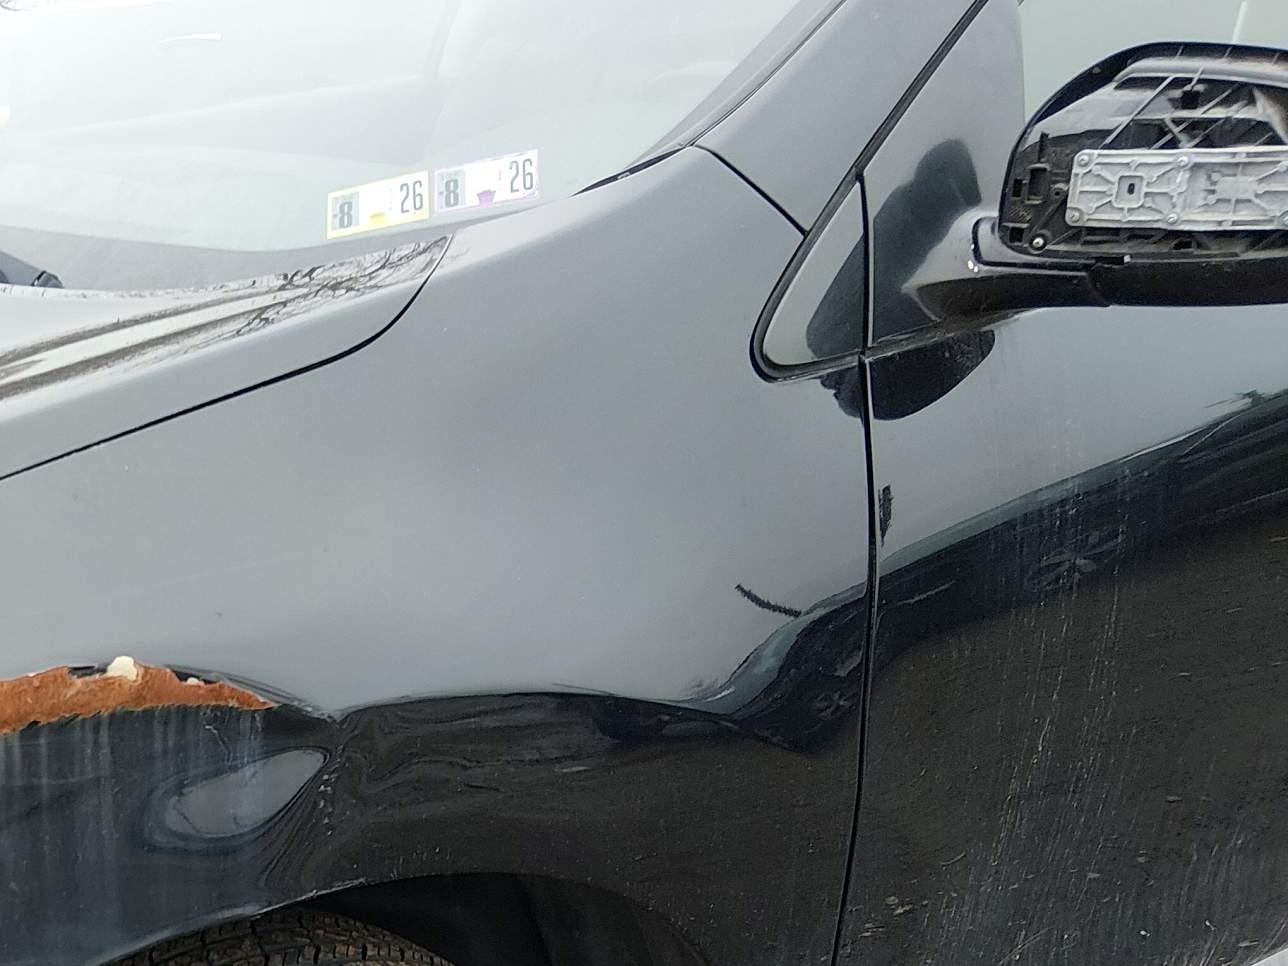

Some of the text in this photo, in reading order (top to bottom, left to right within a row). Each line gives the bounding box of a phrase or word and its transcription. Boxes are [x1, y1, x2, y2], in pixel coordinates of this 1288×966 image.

[338, 179, 424, 229] 8 26
[444, 157, 534, 208] 8 26
